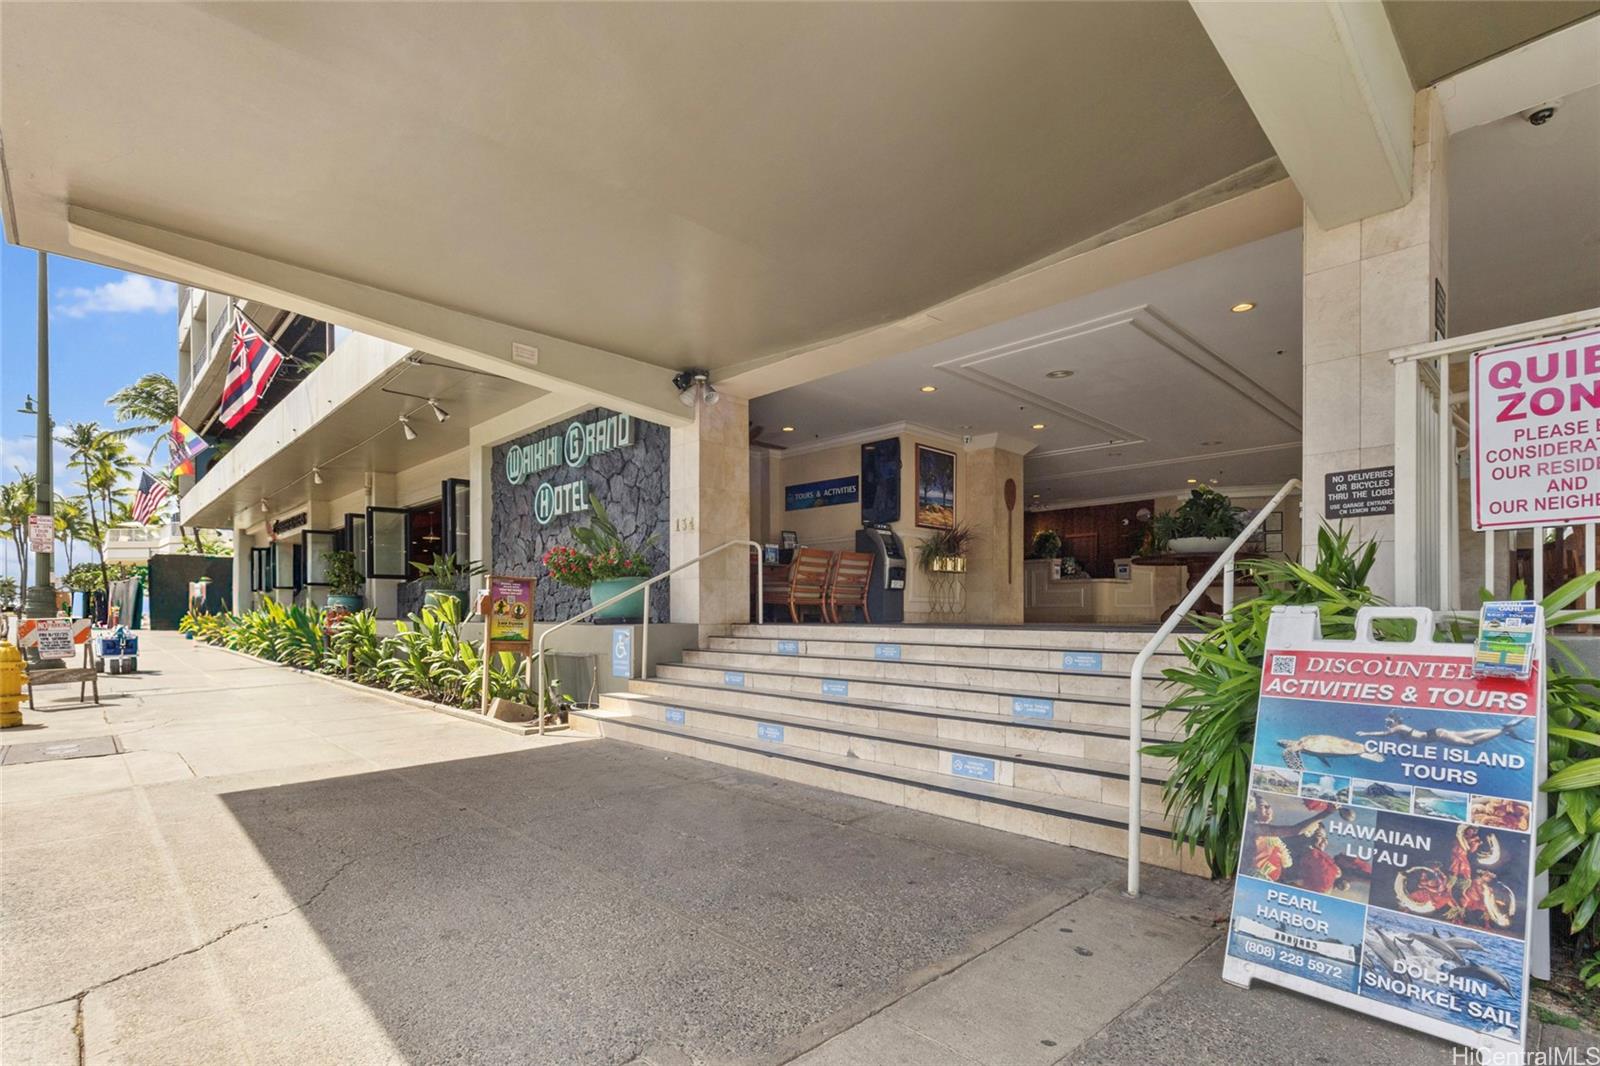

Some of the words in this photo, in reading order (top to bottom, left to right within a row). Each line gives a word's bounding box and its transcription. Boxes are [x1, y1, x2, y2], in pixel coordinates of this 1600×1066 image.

[1514, 420, 1589, 443] PLEASE
[506, 435, 562, 485] WAIKIKI
[564, 414, 633, 468] GRAND
[1331, 475, 1345, 483] NO
[1347, 470, 1393, 482] DELIVERIES
[1492, 464, 1531, 481] OUR
[1546, 476, 1588, 493] AND
[794, 491, 814, 500] TOURS
[816, 490, 821, 498] &
[823, 485, 857, 496] ACTIVITIES
[1328, 492, 1349, 501] THRU
[1352, 490, 1368, 499] THE
[1371, 488, 1395, 497] LOBB
[1335, 483, 1348, 492] OR
[1350, 479, 1390, 490] BICYCLES
[534, 480, 589, 525] HOTEL
[1366, 499, 1395, 507] ENTRANC
[1489, 500, 1529, 515] OUR
[676, 516, 696, 532] 134
[1265, 678, 1394, 701] ACTIVITIES
[1400, 686, 1418, 703] &
[1427, 687, 1529, 711] TOURS
[1364, 739, 1438, 761] CIRCLE
[1443, 748, 1525, 770] ISLAND
[1401, 763, 1478, 786] TOURS
[1328, 820, 1432, 852] HAWAIIAN
[1345, 843, 1408, 868] LU'AU
[1266, 889, 1323, 915] PEARL
[1256, 904, 1330, 936] HARBOR
[1244, 940, 1276, 961] (808)
[1279, 950, 1304, 967] 228
[1307, 959, 1343, 979] 5972
[1392, 959, 1488, 998] DOLPHIN
[1364, 972, 1463, 1013] SNORKEL
[1467, 1002, 1519, 1029] SAIL
